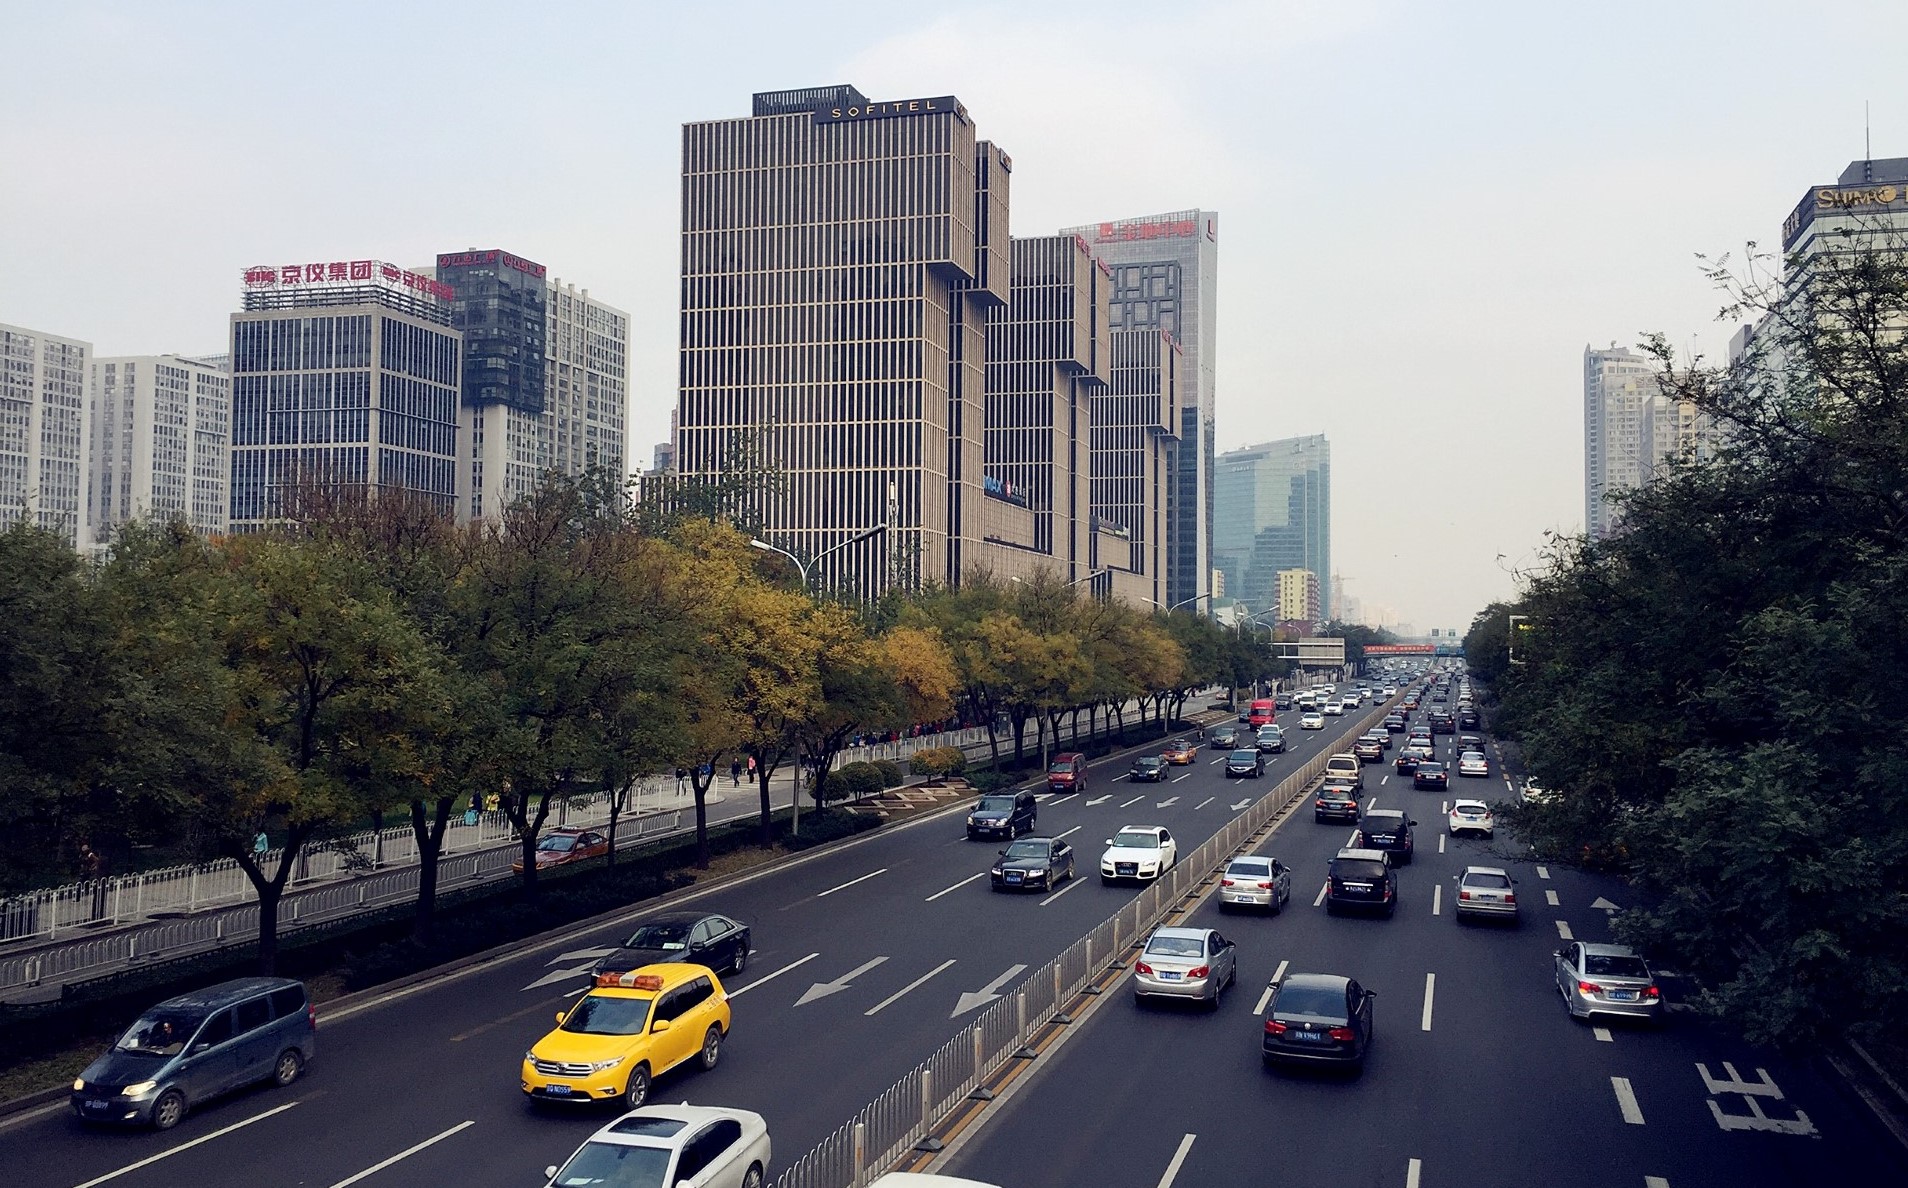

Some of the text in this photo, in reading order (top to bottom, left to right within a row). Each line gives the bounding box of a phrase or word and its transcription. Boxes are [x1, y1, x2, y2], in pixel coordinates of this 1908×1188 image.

[832, 101, 936, 118] SOFITEL
[281, 260, 372, 285] 京仪集团
[1695, 1061, 1822, 1139] 出
